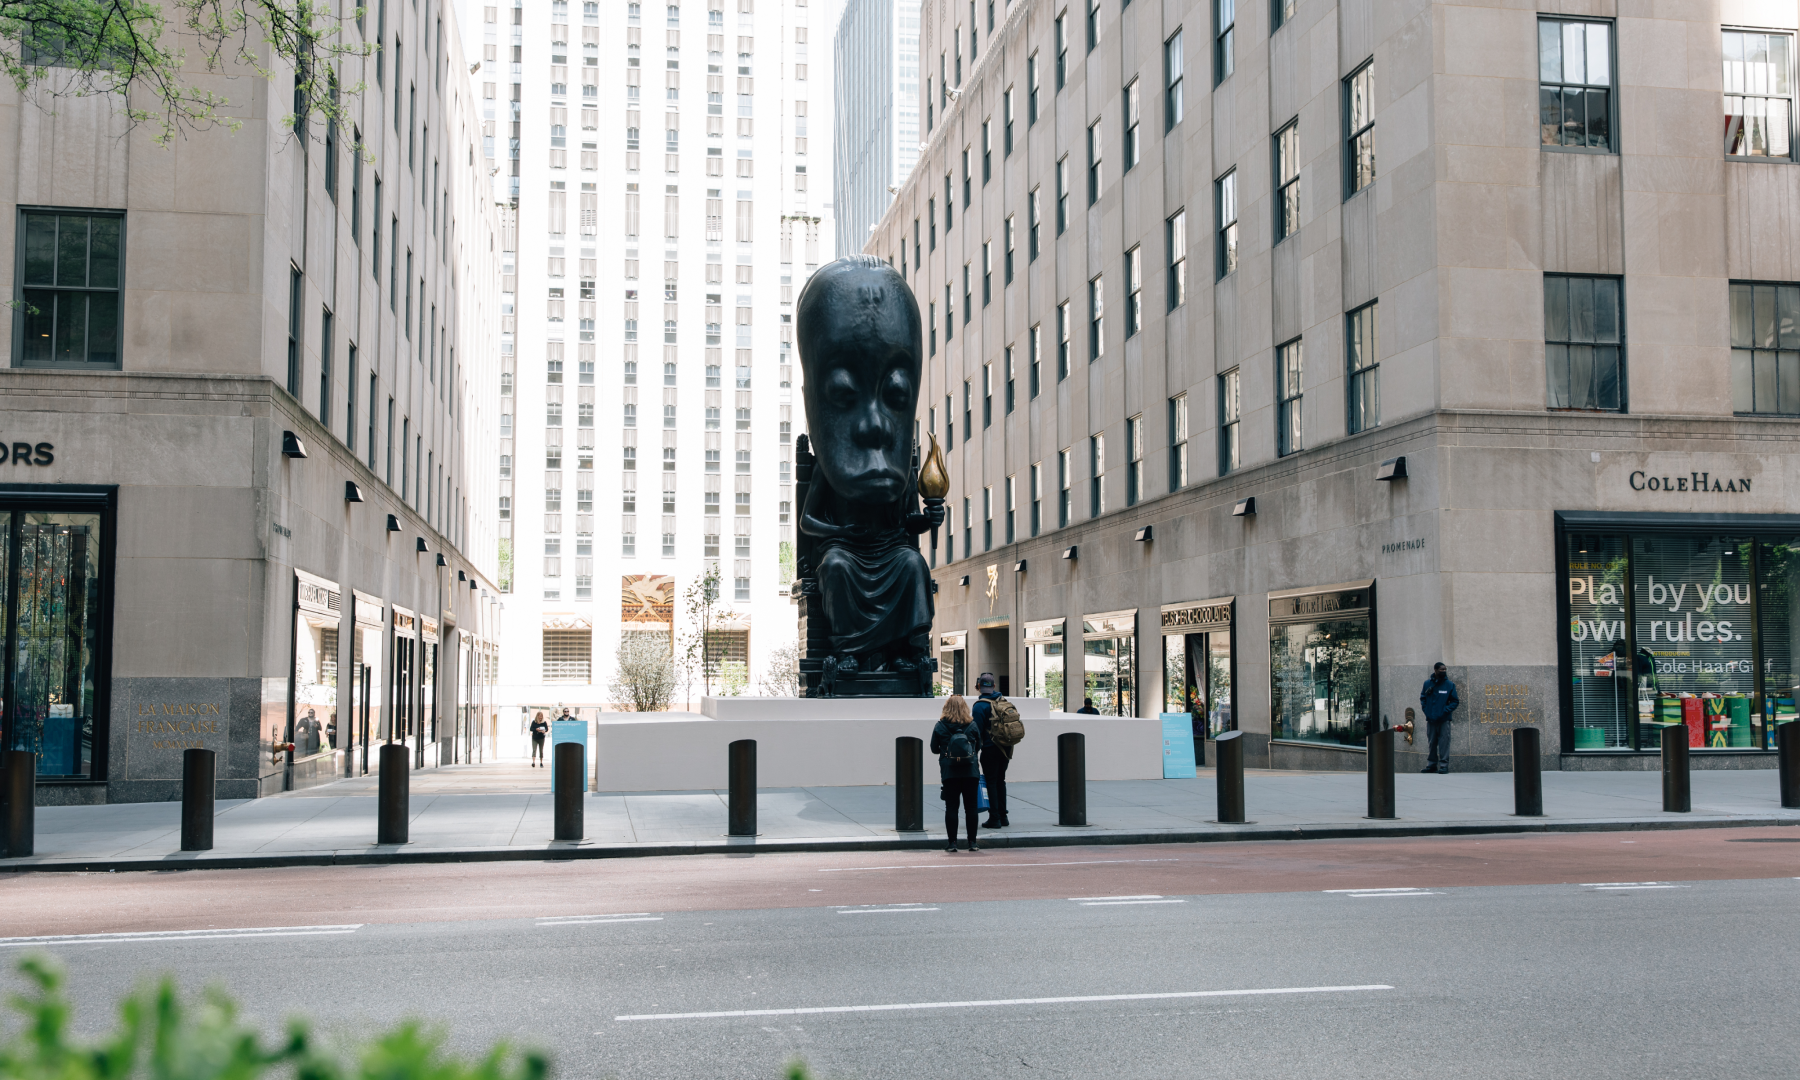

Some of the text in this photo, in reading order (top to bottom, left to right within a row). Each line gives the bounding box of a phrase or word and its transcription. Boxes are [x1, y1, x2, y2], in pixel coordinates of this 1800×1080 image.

[1382, 538, 1425, 554] PROMENADE
[1570, 562, 1589, 570] RULE
[1648, 575, 1686, 612] by
[1651, 612, 1742, 642] rules.
[1692, 660, 1735, 673] Haan
[1738, 658, 1773, 673] Gf
[1485, 684, 1528, 695] BRITISH
[139, 703, 220, 716] LA MAISON
[1486, 698, 1528, 710] EMPIRE
[1480, 712, 1535, 724] BUILDING
[138, 720, 219, 735] FRANÇAISE
[153, 740, 204, 749] MCMXXXIII
